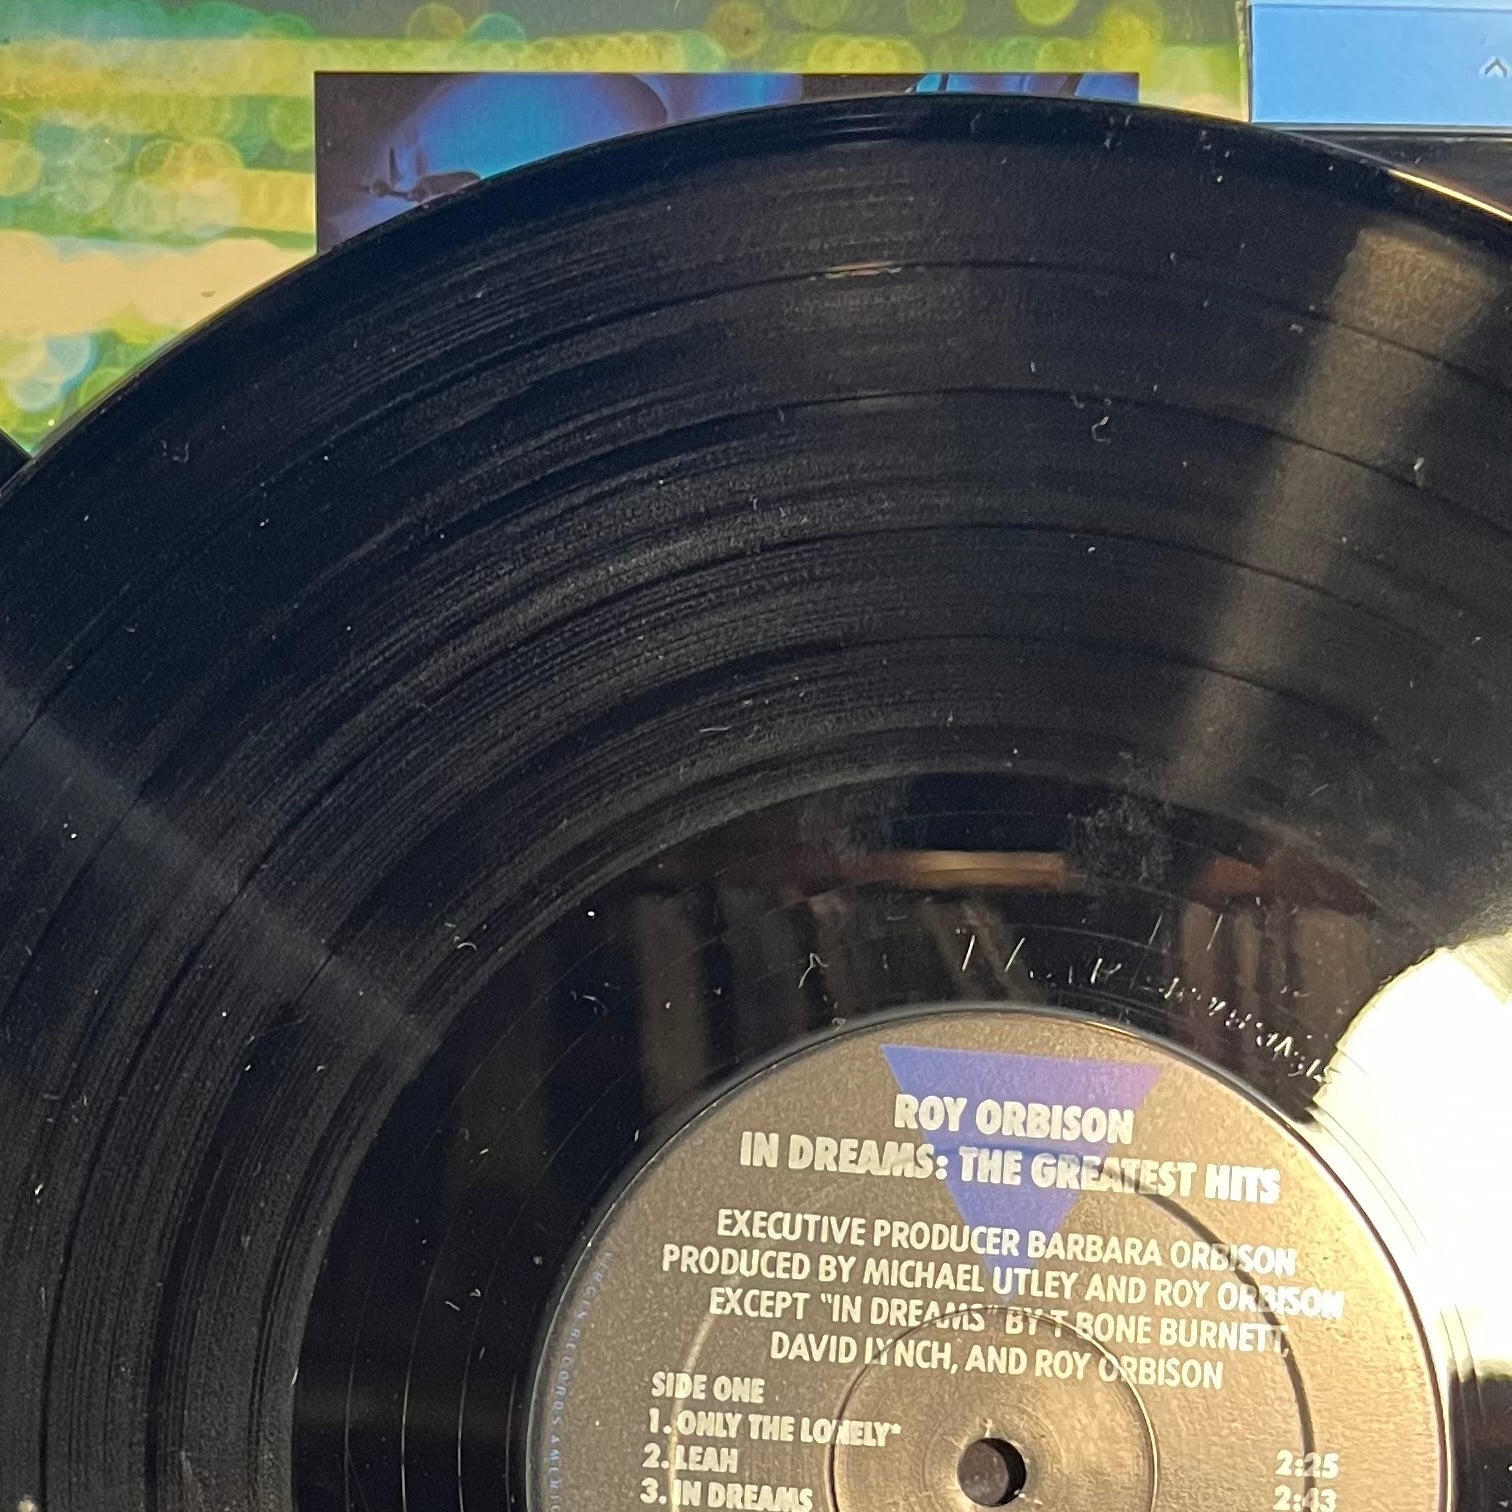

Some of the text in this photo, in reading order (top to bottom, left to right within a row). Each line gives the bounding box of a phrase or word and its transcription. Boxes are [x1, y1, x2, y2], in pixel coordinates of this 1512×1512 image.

[894, 1093, 1135, 1145] ROY ORBISON
[739, 1131, 1281, 1205] IN DREAMS: THE GREATEST HITS
[717, 1208, 1298, 1277] EXECUTIVE PRODUCER BARBARA ORBISON
[662, 1243, 1345, 1319] PRODUCED BY MICHAEL UTLEY AND ROY ORBISON
[709, 1286, 810, 1320] EXCEPT
[1005, 1306, 1044, 1336] BY
[1076, 1309, 1152, 1344] BONE
[770, 1331, 1224, 1390] DAVID LYNCH, AND ROY ORBISON
[651, 1371, 765, 1403] SIDE ONE
[648, 1408, 672, 1434] 1.
[677, 1410, 742, 1438] ONLY
[749, 1414, 795, 1441] THE
[642, 1443, 738, 1473] 2. LEAH
[1274, 1449, 1339, 1479] 2:25
[639, 1477, 668, 1505] 3.
[672, 1479, 701, 1506] IN
